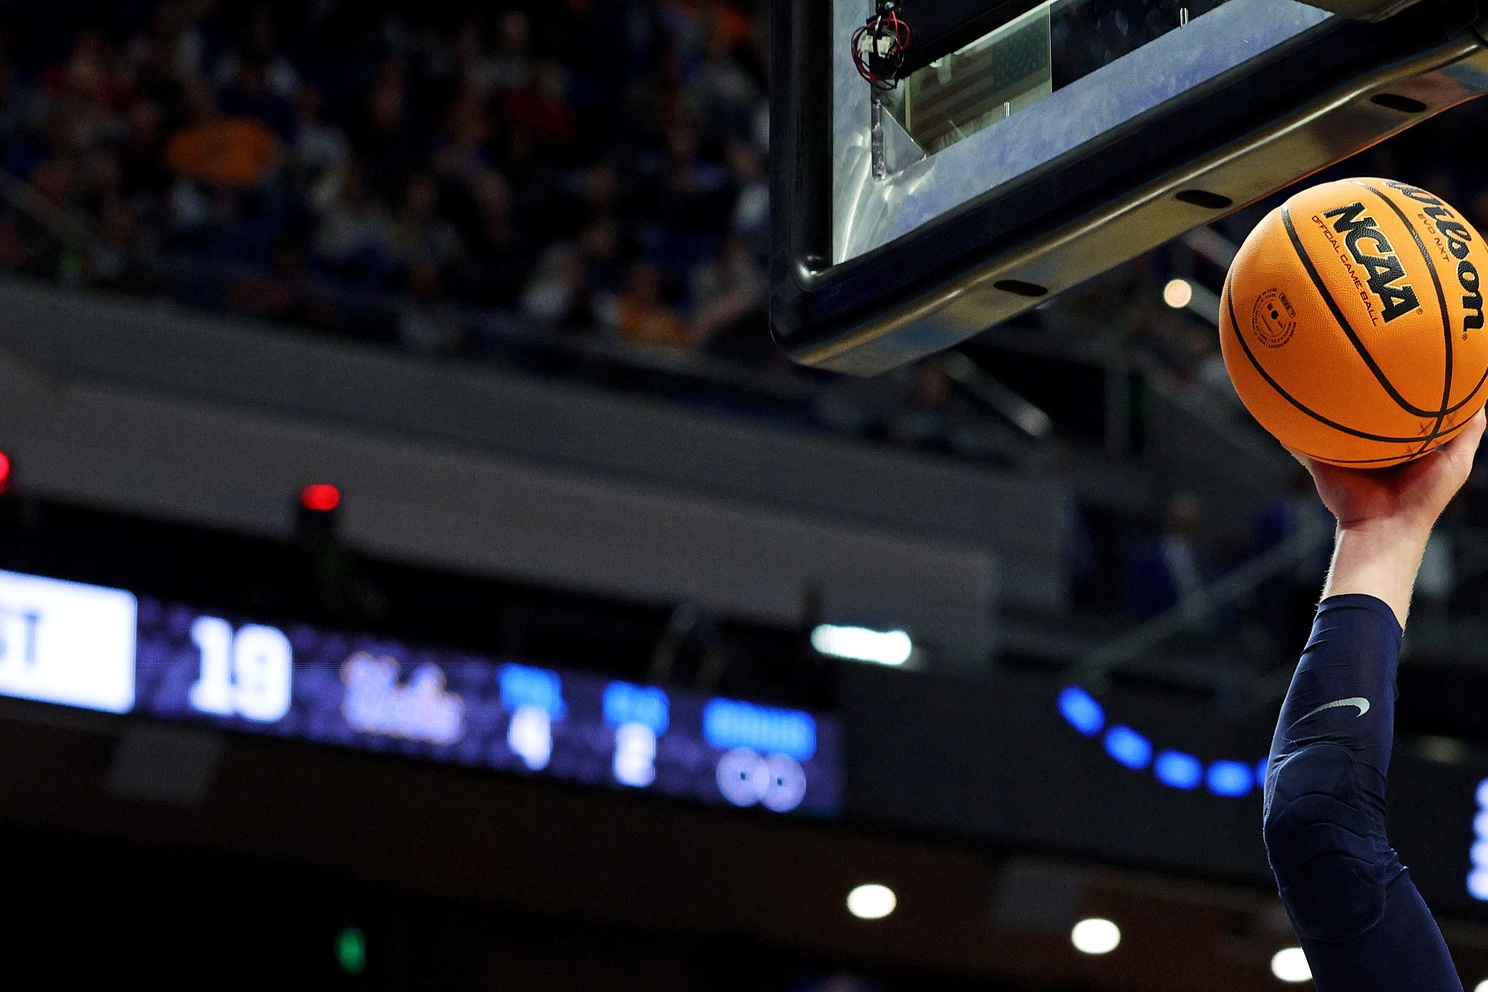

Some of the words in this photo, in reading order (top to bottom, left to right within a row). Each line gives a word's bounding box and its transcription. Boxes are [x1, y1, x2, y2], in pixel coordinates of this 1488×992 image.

[1311, 215, 1340, 254] OFFICIAL
[1339, 254, 1363, 290] GAME
[1360, 291, 1379, 327] BALL
[1322, 201, 1421, 323] NCAA
[1417, 213, 1436, 235] EVO
[1433, 237, 1450, 262] NXT
